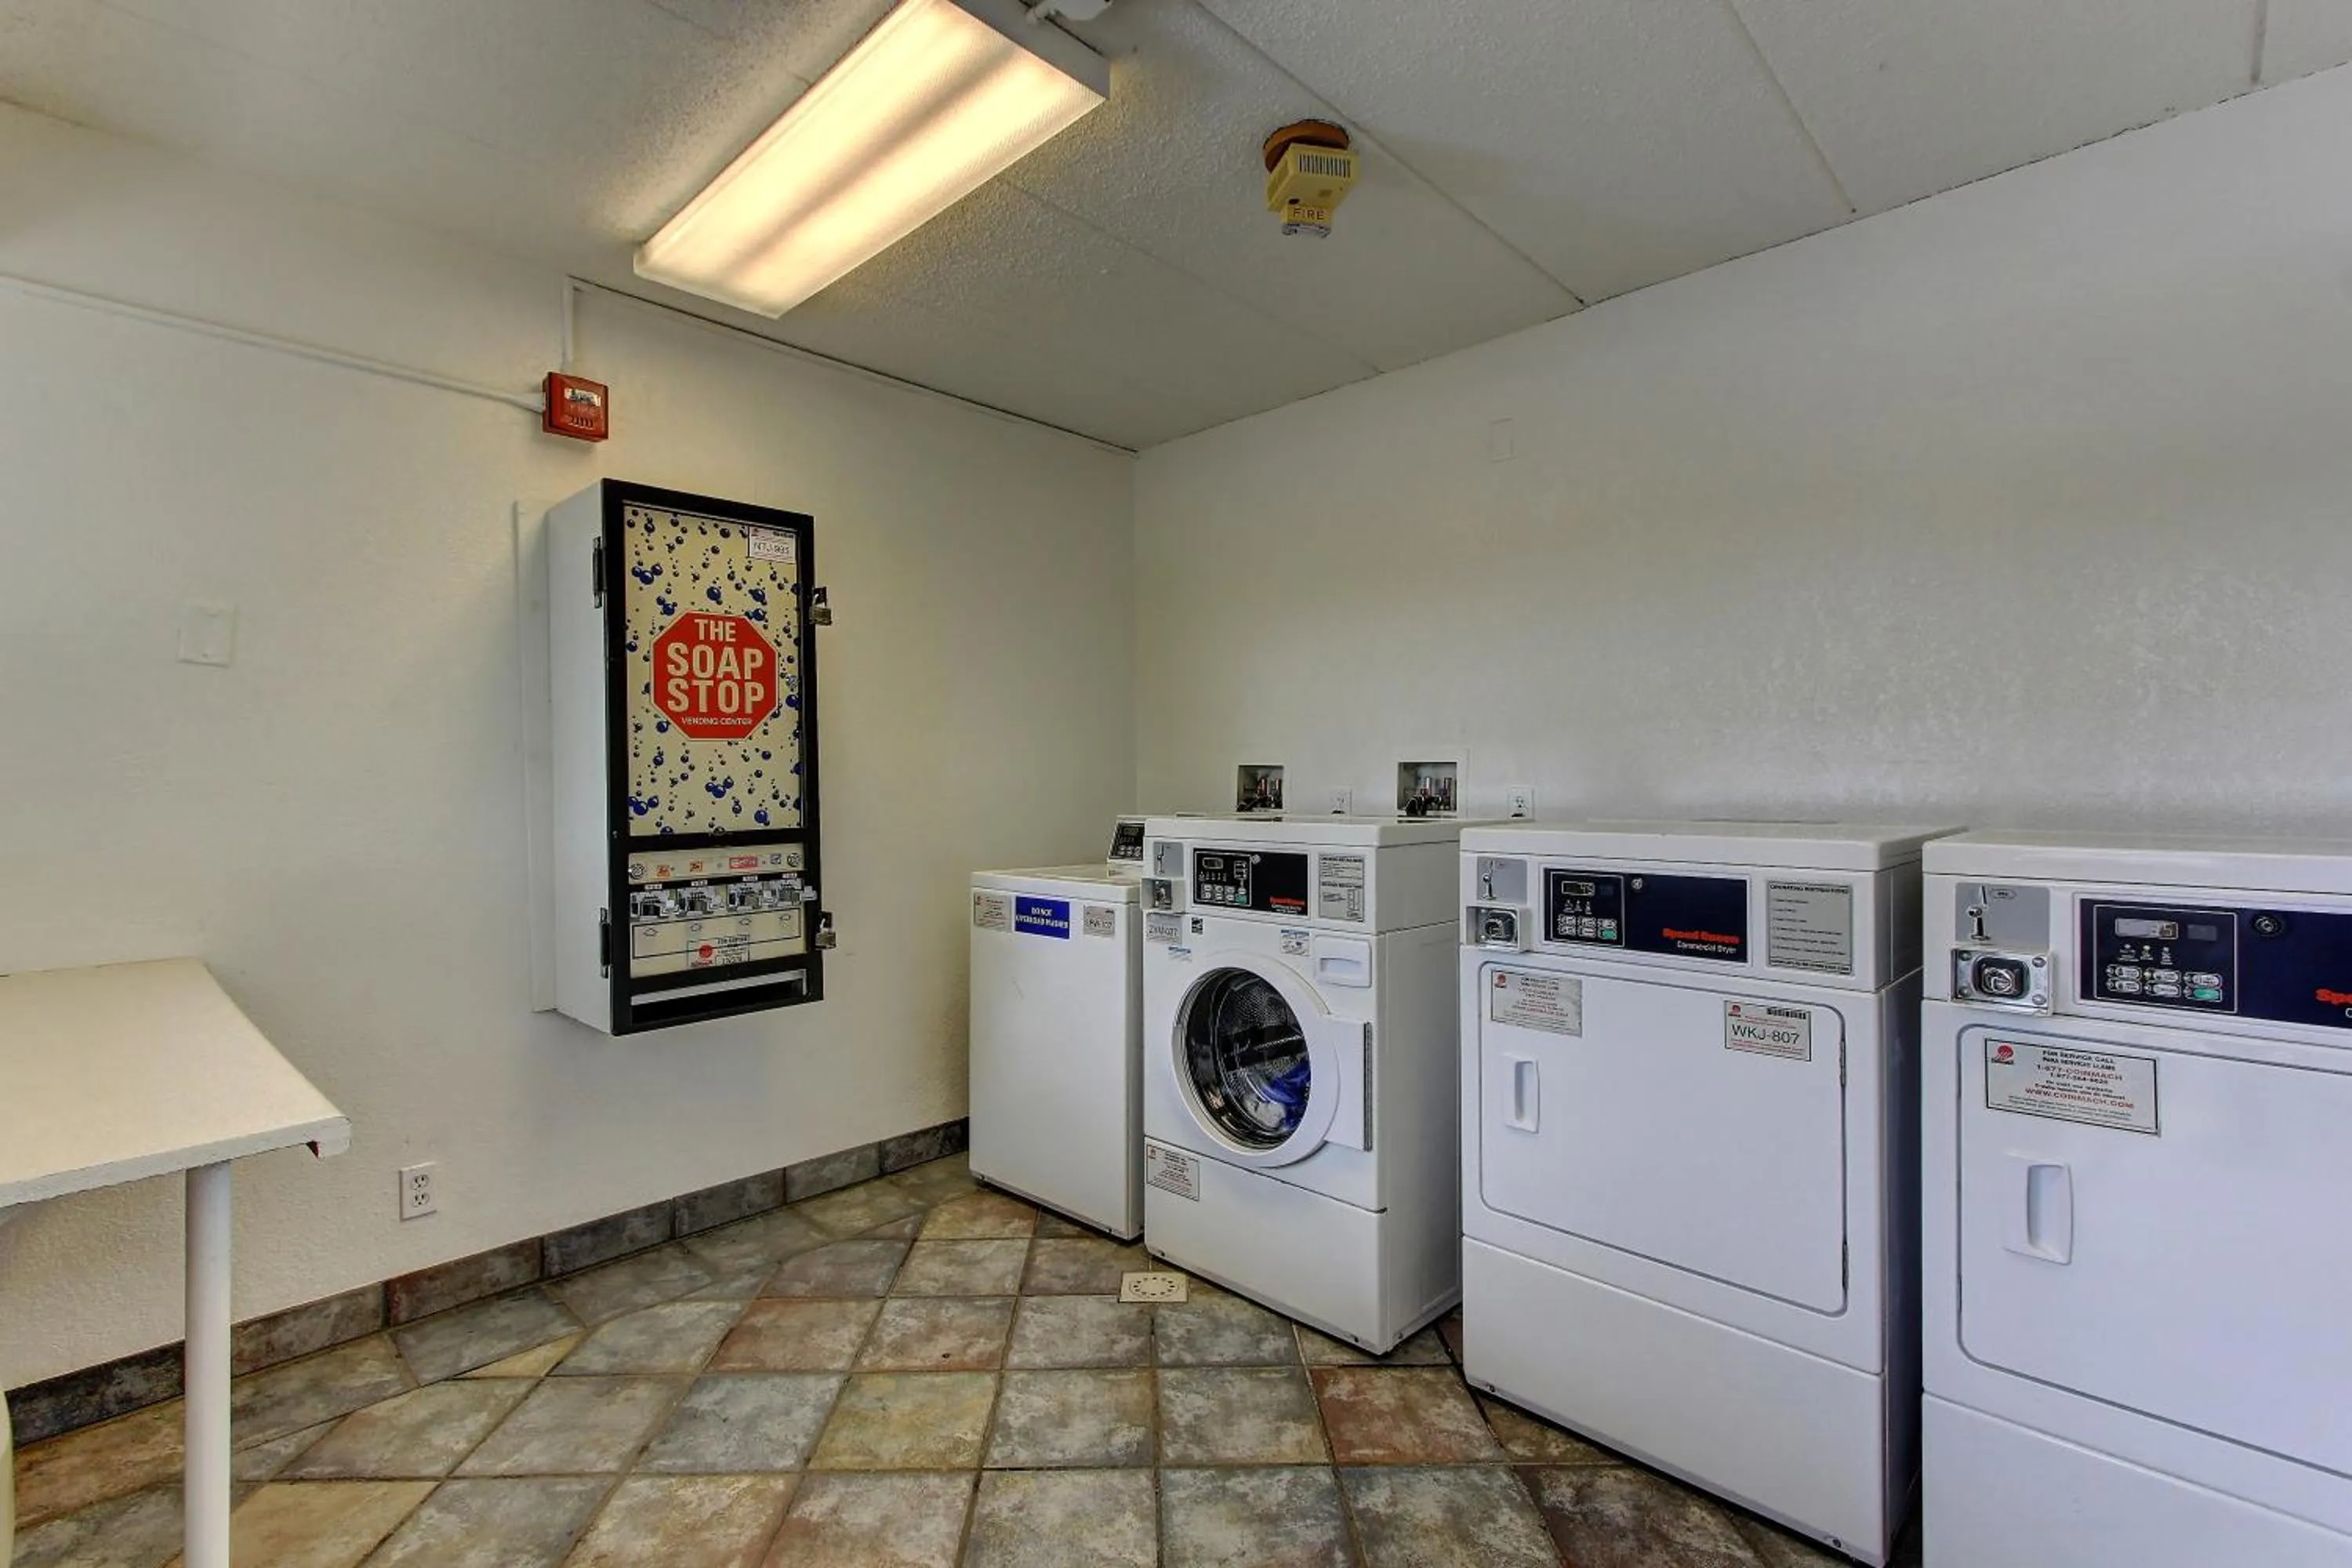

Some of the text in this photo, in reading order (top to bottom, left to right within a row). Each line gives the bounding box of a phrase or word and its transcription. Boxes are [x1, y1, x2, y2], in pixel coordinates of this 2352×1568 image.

[1294, 208, 1324, 220] FIRE
[694, 619, 737, 642] THE
[666, 642, 764, 680] SOAP
[666, 677, 765, 714] STOP
[681, 717, 719, 725] VENDING
[1717, 945, 1737, 954] Dryer
[1731, 1024, 1800, 1044] WKJ-807
